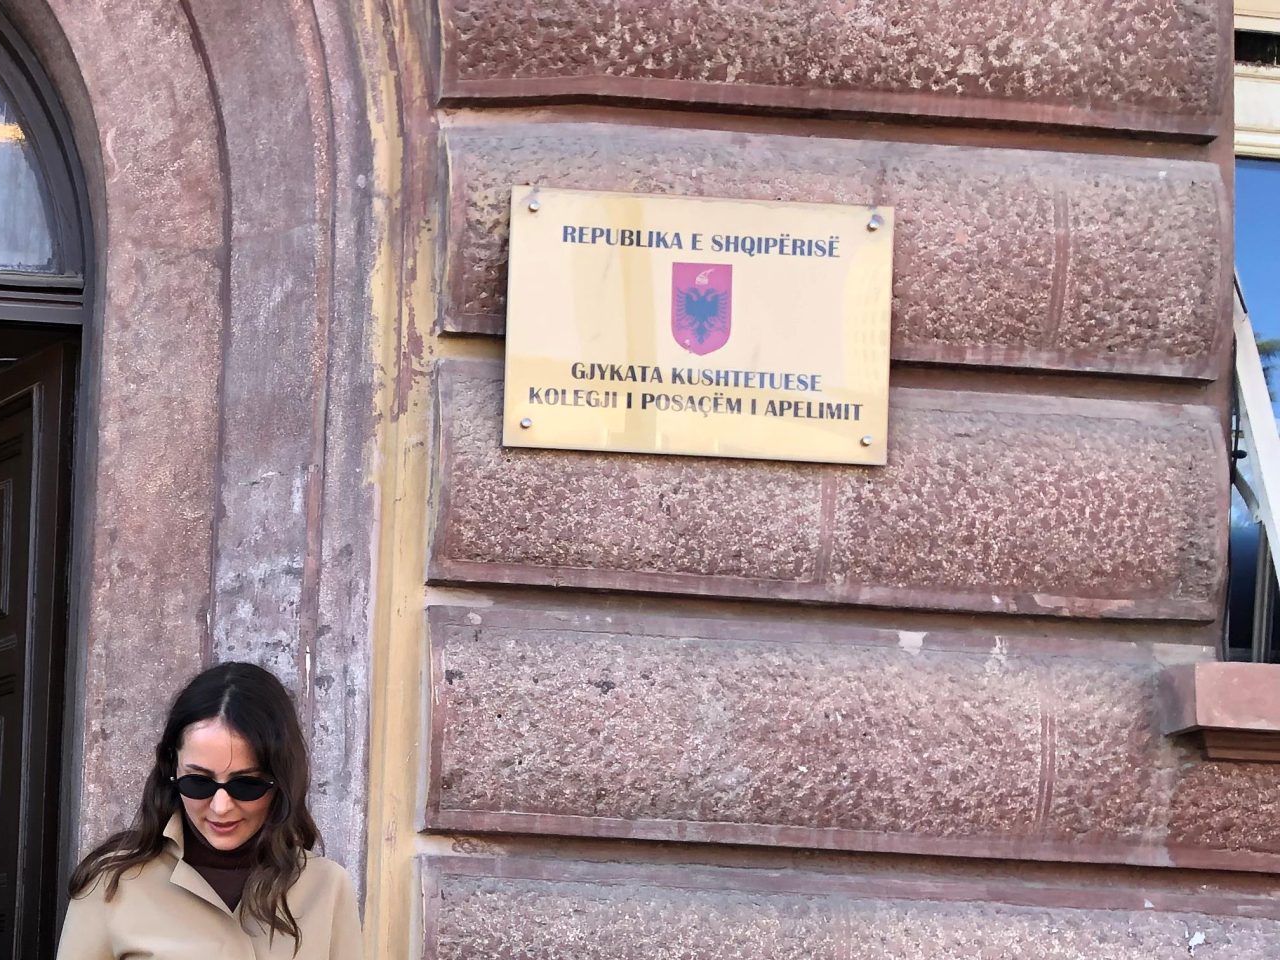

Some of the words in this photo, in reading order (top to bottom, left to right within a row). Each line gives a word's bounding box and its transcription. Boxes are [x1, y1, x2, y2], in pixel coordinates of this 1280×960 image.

[562, 225, 682, 249] REPUBLIKA
[691, 233, 702, 250] E
[711, 233, 840, 258] SHQIPËRISË
[571, 362, 662, 384] GJYKATA
[671, 367, 822, 392] KUSHTETUESE
[529, 387, 617, 408] KOLEGJI
[626, 392, 632, 409] I
[641, 393, 742, 417] POSAÇËM
[751, 399, 756, 415] I
[764, 399, 863, 421] APELIMIT
